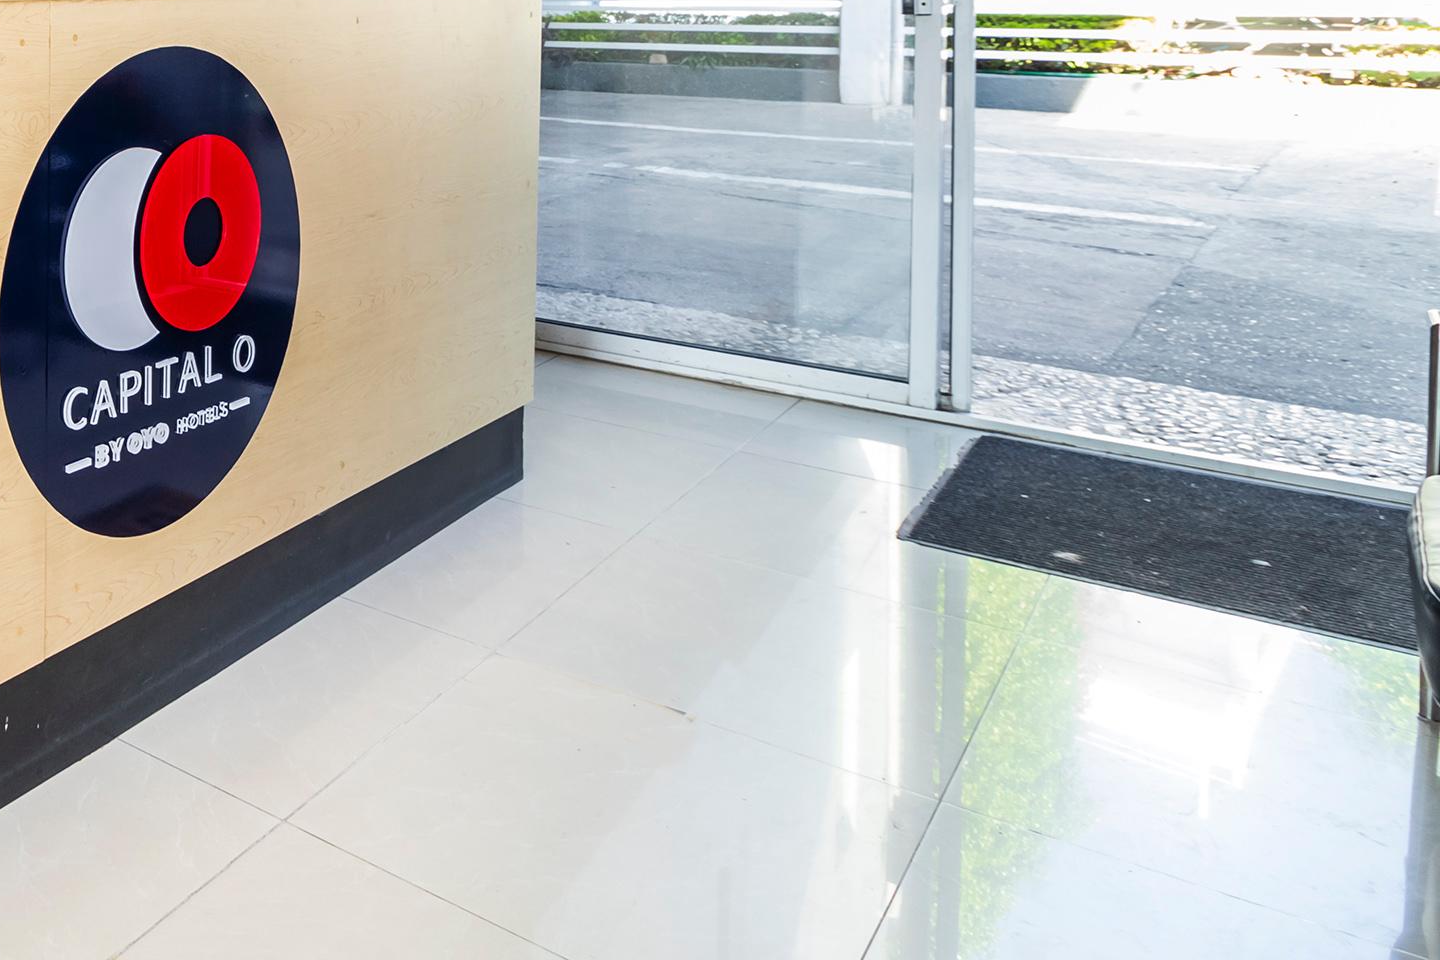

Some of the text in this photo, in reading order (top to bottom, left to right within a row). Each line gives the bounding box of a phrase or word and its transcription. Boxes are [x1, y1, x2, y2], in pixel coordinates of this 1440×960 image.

[62, 334, 256, 431] CAPITAL O
[94, 401, 229, 469] BY OYO HOTELS
